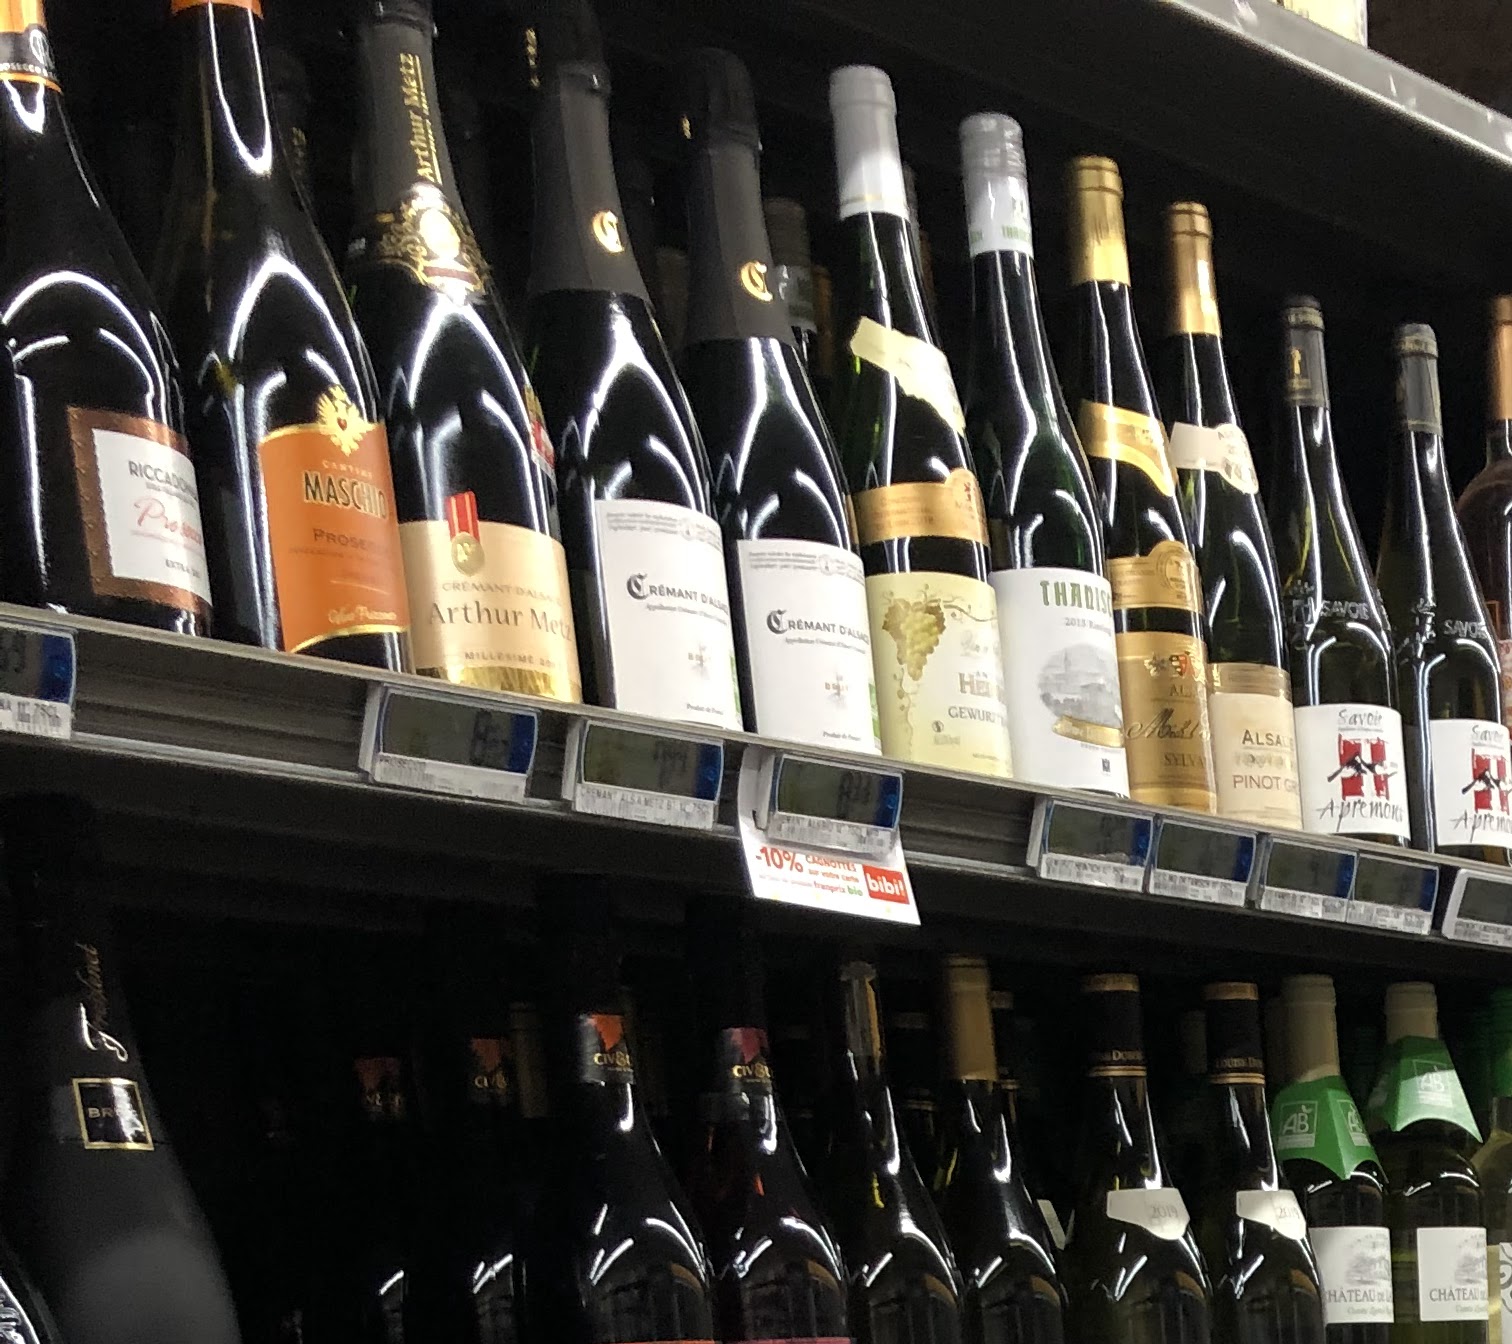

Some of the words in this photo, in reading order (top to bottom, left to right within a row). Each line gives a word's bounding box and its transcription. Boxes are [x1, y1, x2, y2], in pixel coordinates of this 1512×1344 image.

[303, 471, 389, 519] MASCHIO
[626, 572, 698, 602] CRÉMANT
[428, 600, 524, 628] Arthur
[529, 604, 573, 643] Metz
[766, 608, 836, 636] CRÉMANT
[1338, 708, 1384, 729] Savoie
[1232, 773, 1281, 792] PINOT
[755, 847, 804, 873] -10%
